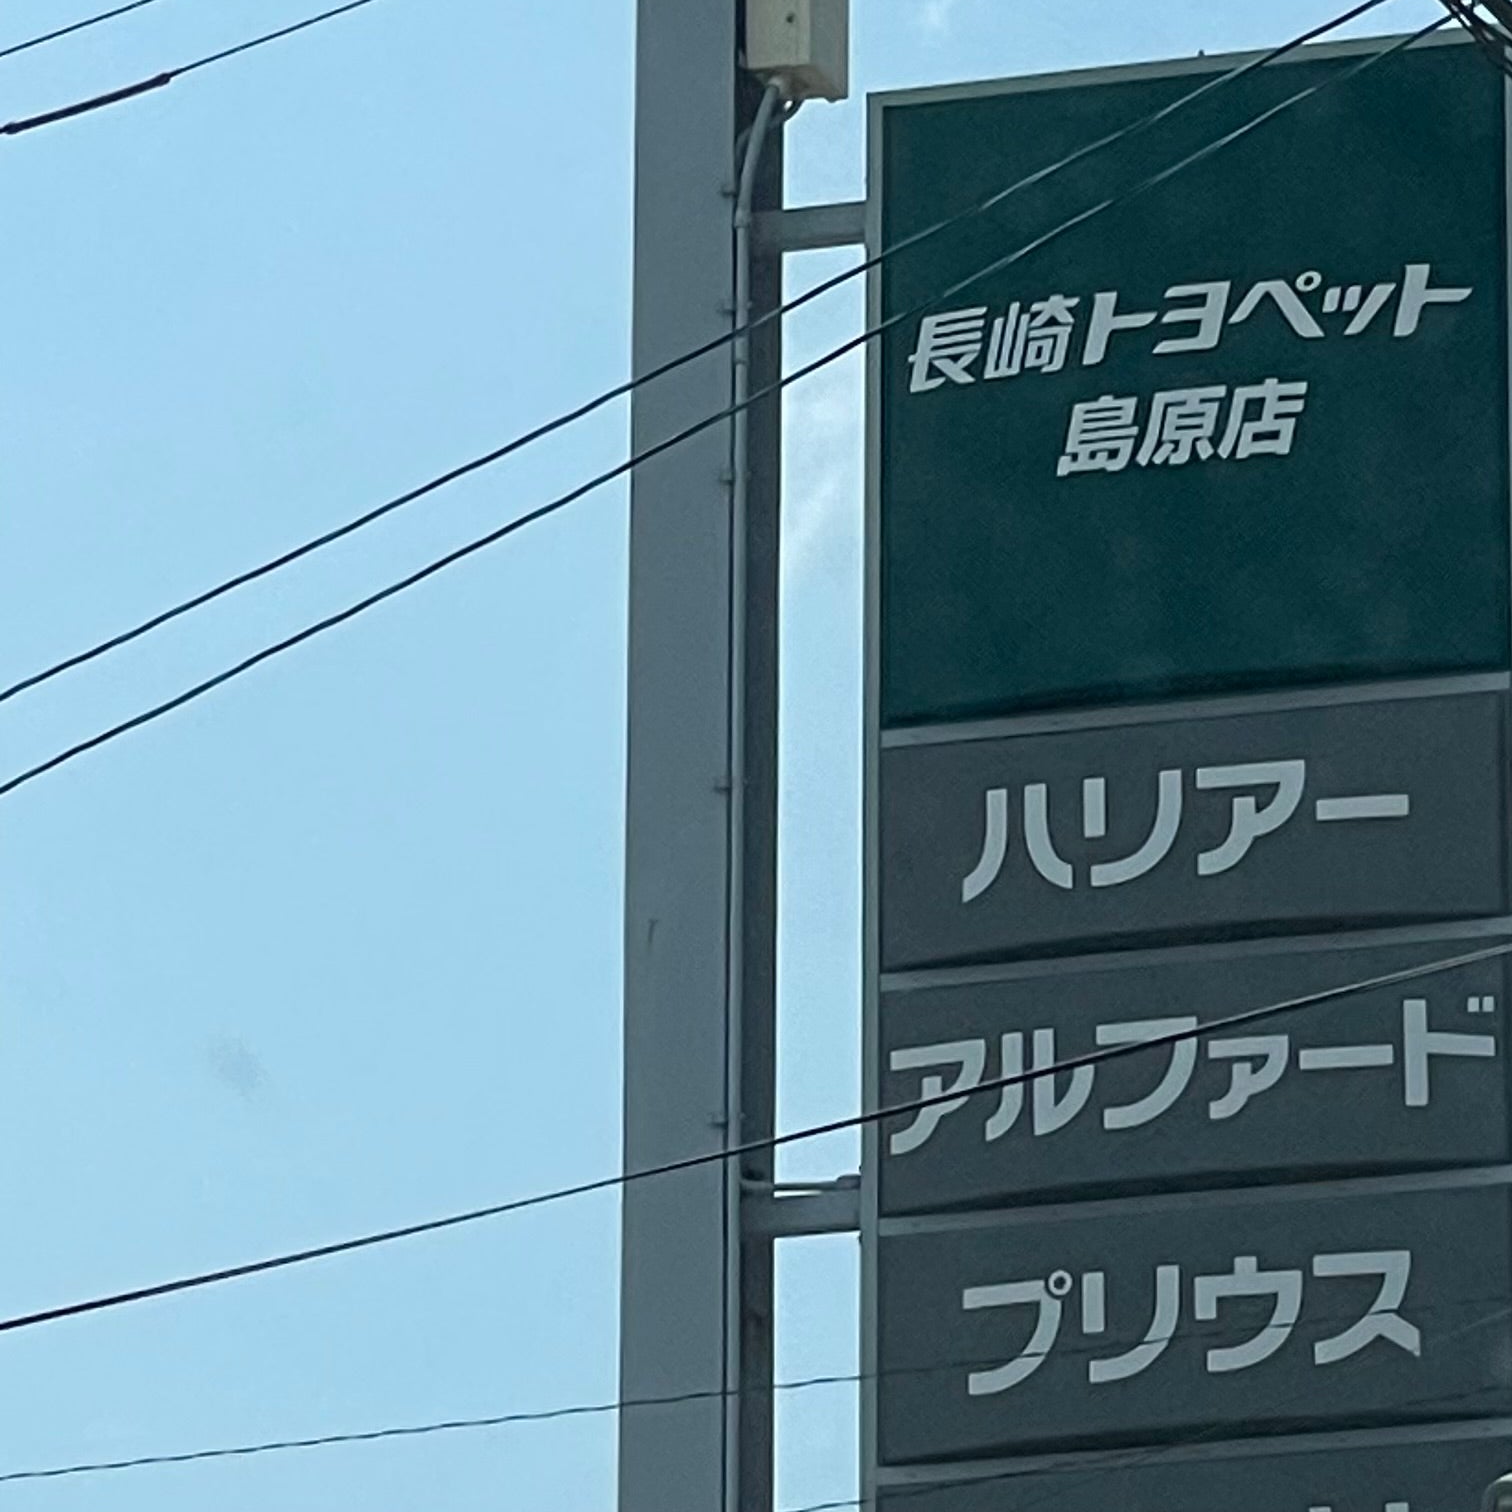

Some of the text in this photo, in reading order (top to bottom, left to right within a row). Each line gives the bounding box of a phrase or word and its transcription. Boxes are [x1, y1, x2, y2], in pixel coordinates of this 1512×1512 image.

[908, 263, 1473, 394] 長崎トヨペット
[1056, 378, 1307, 477] 島原店
[962, 759, 1409, 903] ハリアー
[890, 995, 1496, 1156] アルファード
[962, 1249, 1421, 1396] プリウス
